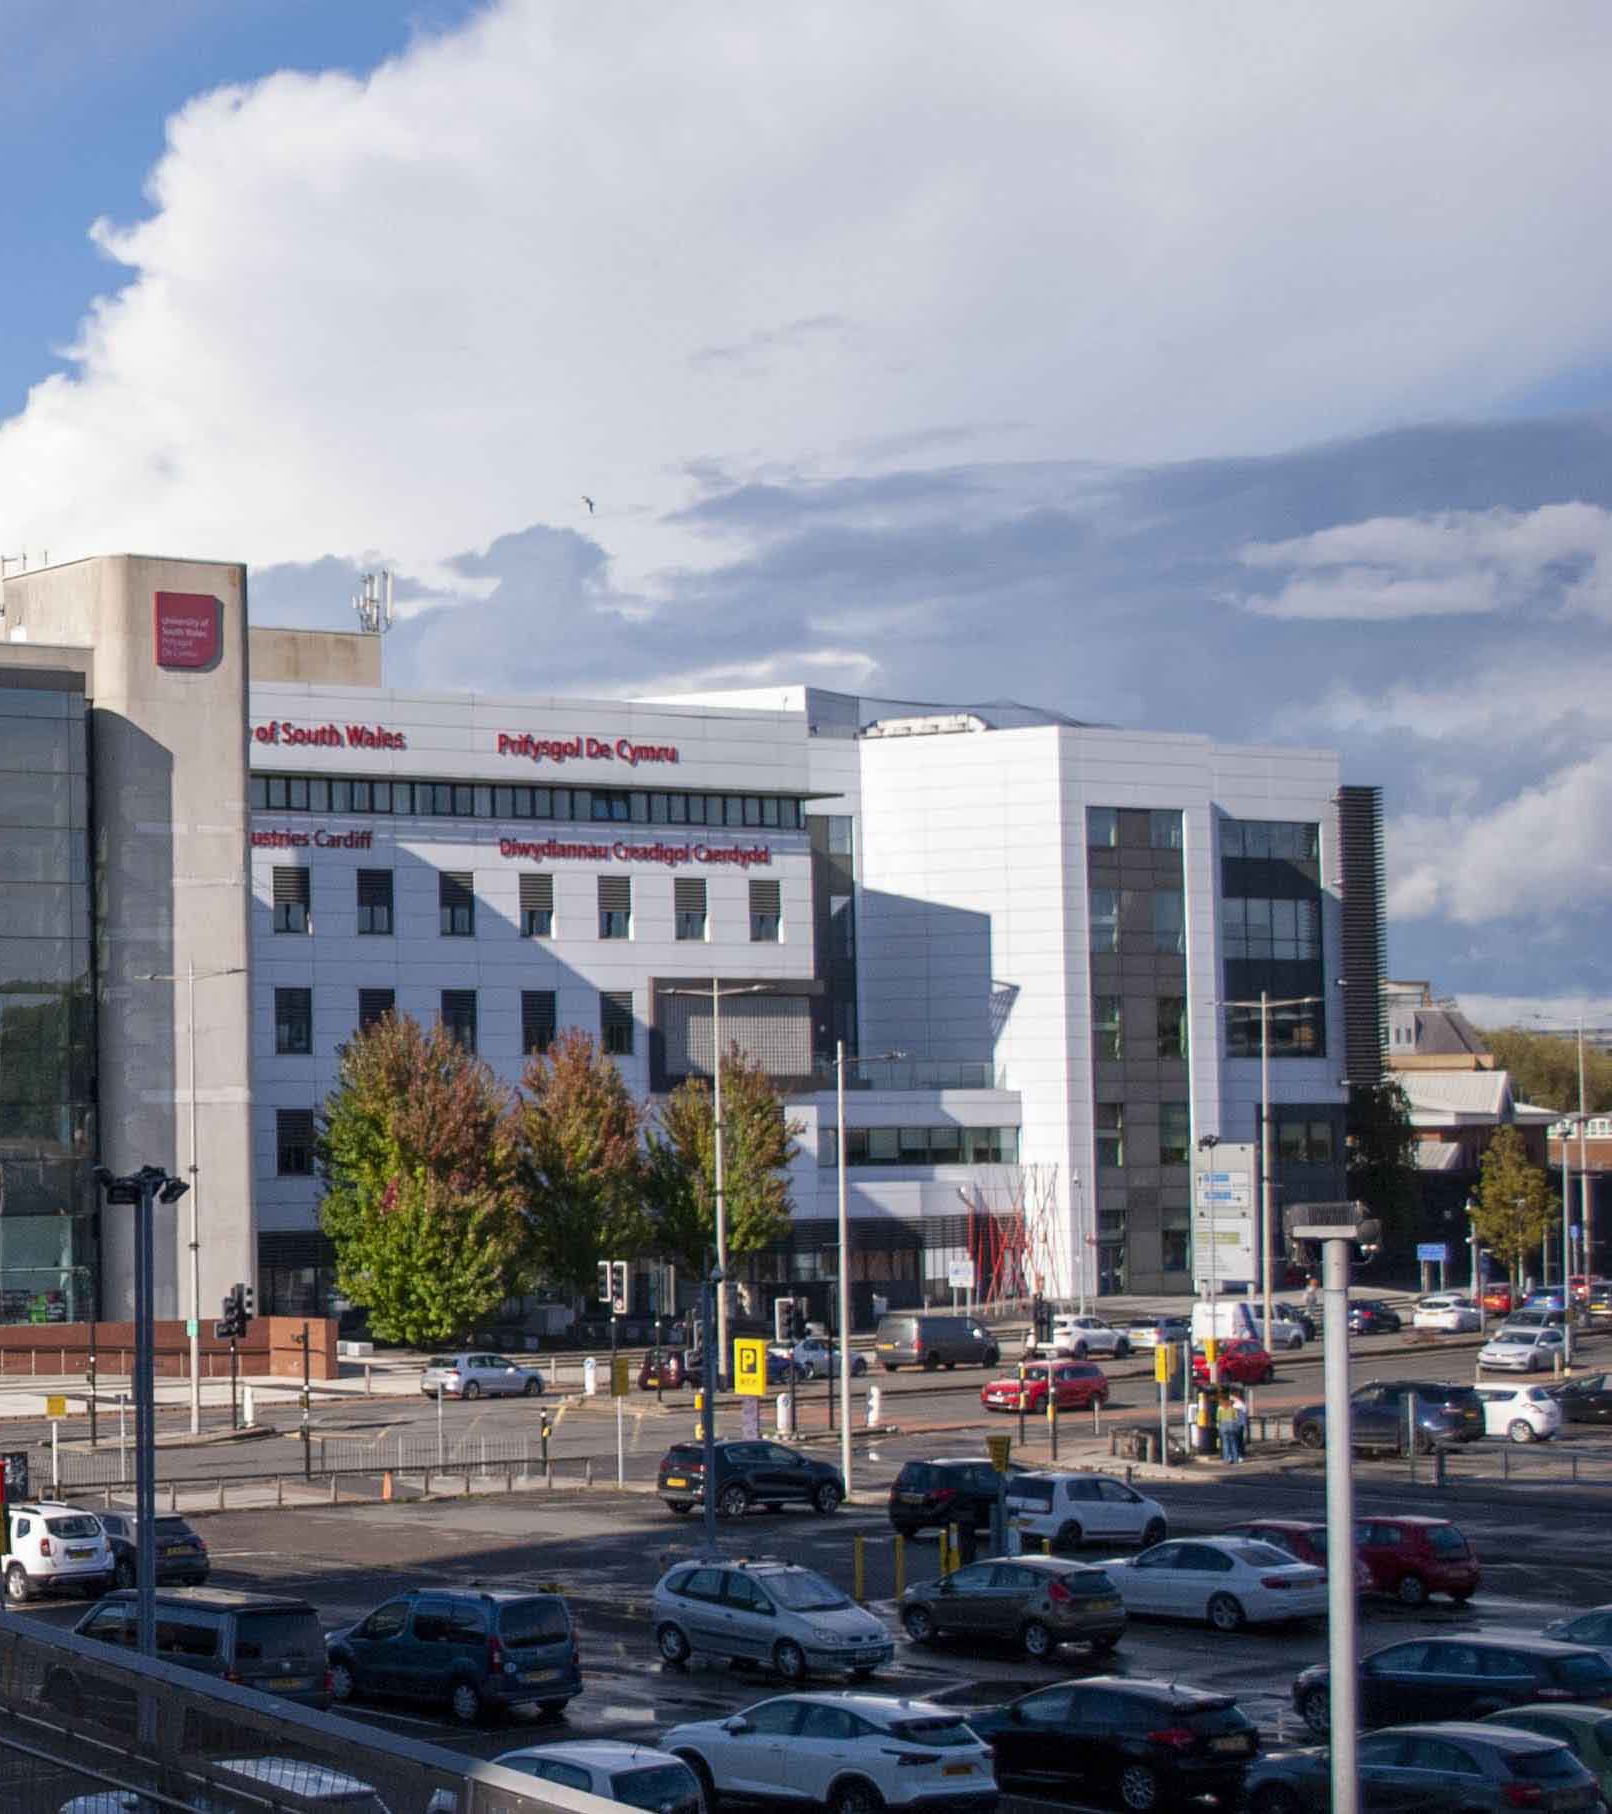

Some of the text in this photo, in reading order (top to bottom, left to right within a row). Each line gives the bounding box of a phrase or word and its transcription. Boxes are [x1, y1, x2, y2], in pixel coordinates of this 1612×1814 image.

[255, 720, 407, 750] of South Wales
[497, 733, 680, 767] Prifysgol De Cymru
[314, 829, 373, 849] Cardiff
[499, 838, 772, 870] Diwydiannau Creadigol Caerdydd
[742, 1350, 755, 1372] P
